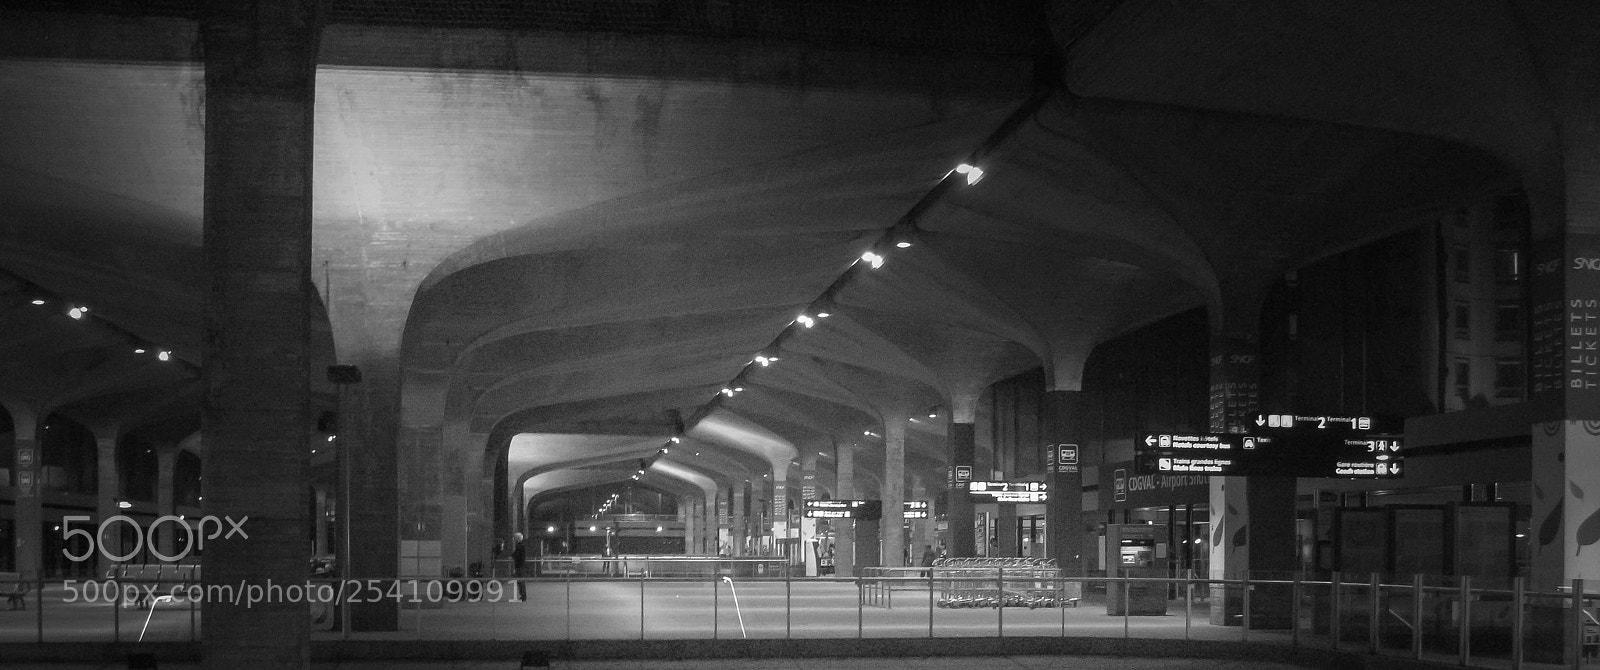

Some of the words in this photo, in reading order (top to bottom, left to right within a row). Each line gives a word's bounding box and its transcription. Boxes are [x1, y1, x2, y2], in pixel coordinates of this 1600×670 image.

[1572, 257, 1600, 270] SNC
[1570, 299, 1582, 388] BILLETS
[1585, 299, 1597, 389] TICKETS
[1317, 416, 1326, 429] 2
[1351, 417, 1357, 430] 1
[1367, 440, 1375, 452] 3
[1172, 464, 1189, 472] Main
[1190, 458, 1214, 466] grandes
[1128, 474, 1156, 491] CDGVAL
[1160, 474, 1189, 491] Airport
